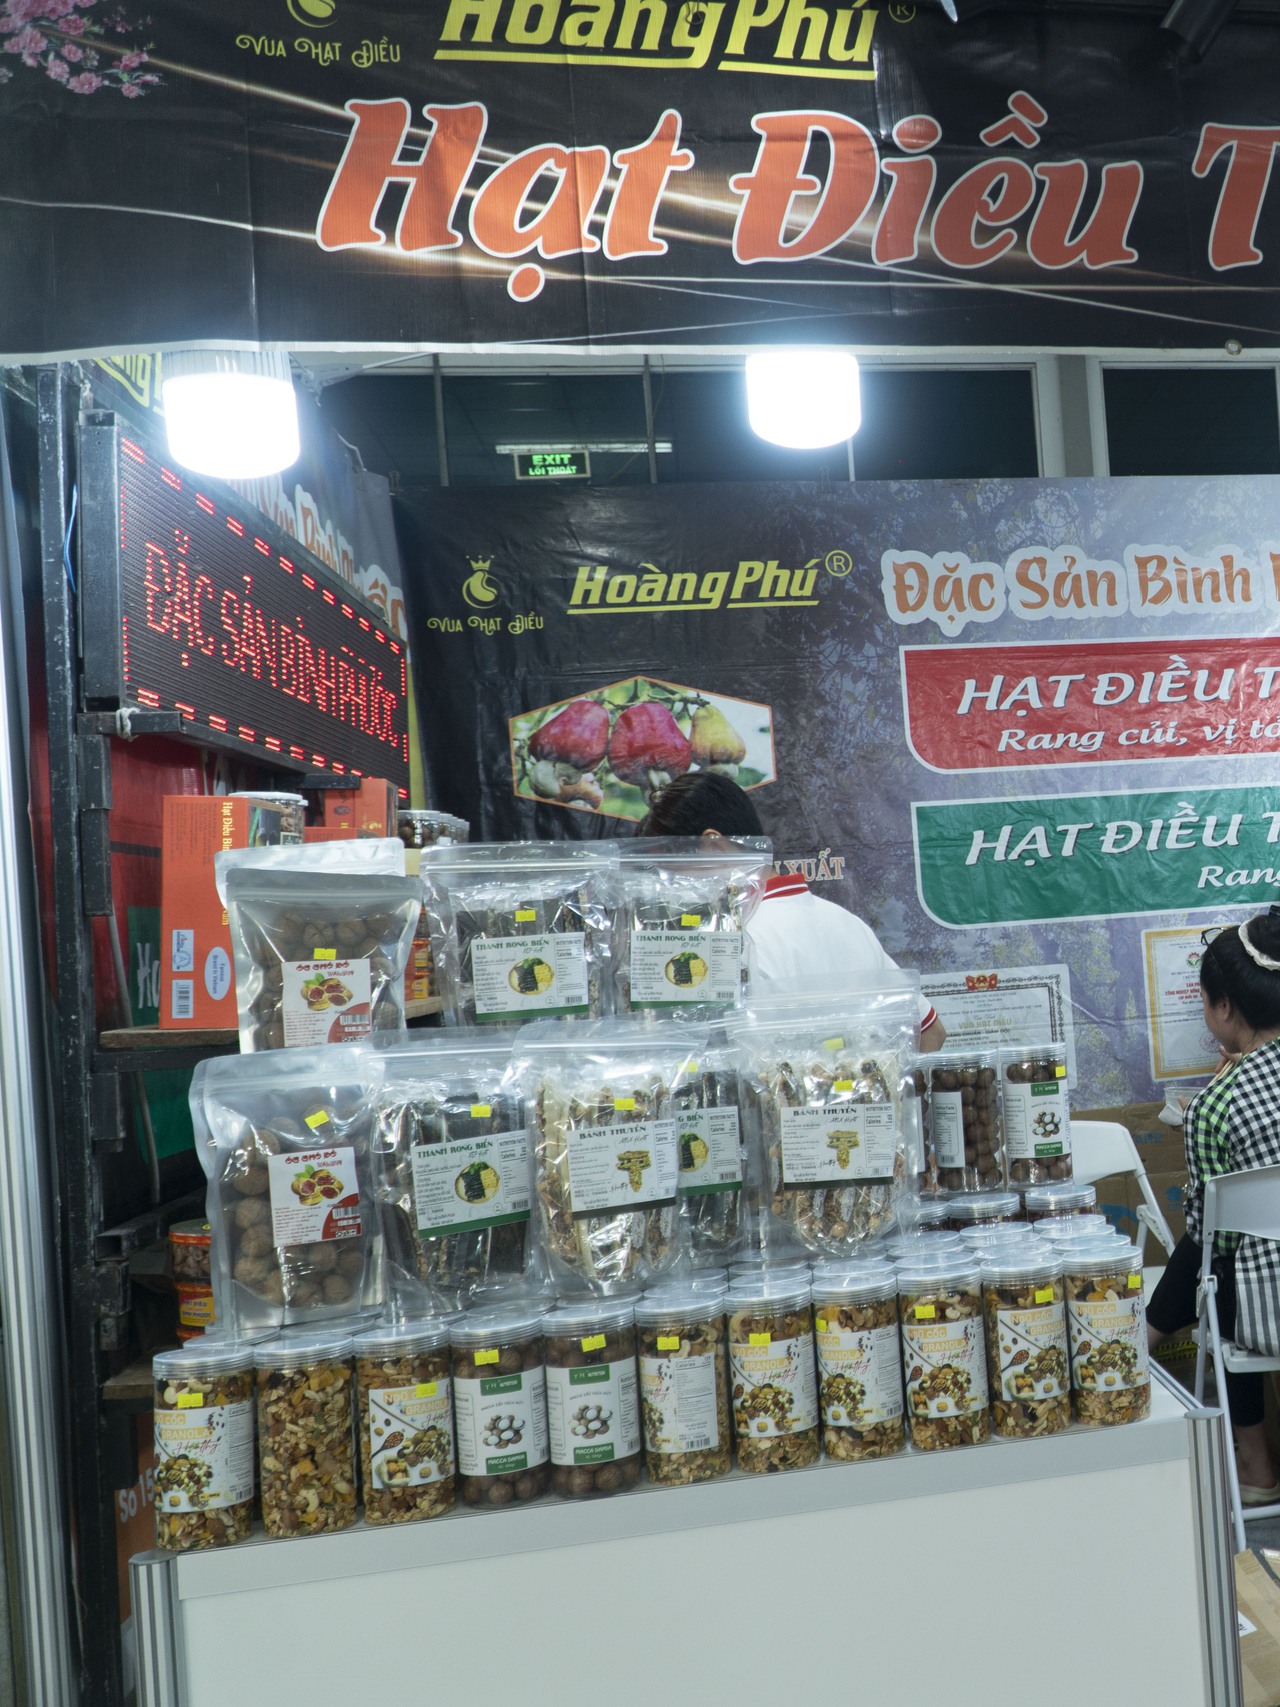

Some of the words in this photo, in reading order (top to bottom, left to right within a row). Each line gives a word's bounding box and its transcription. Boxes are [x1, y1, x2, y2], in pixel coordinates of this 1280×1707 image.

[236, 35, 287, 57] VUA
[294, 37, 342, 66] HẠT
[351, 36, 401, 68] ĐIỀU
[315, 97, 694, 302] Hạt
[729, 90, 1143, 271] Điều
[532, 453, 572, 465] EXIT
[547, 464, 577, 475] THOÁT
[568, 559, 822, 612] HoàngPhú
[891, 560, 997, 623] Đặc
[1014, 552, 1119, 609] Sản
[1133, 552, 1253, 606] Bình
[144, 529, 217, 666] ĐẶC
[220, 574, 279, 688] SẢN
[427, 616, 463, 633] VUA
[468, 615, 502, 636] HẠT
[508, 610, 544, 635] ĐIỀU
[957, 671, 1088, 718] HẠT
[1091, 654, 1235, 706] ĐIỀU
[996, 726, 1106, 753] Rang
[1117, 718, 1188, 748] củi,
[1202, 716, 1238, 744] vị
[964, 822, 1097, 869] HẠT
[1099, 801, 1244, 855] ĐIỀU
[665, 934, 686, 942] RONG
[475, 940, 504, 951] THANH
[506, 939, 529, 949] RONG
[793, 1109, 819, 1117] BÁNH
[579, 1128, 607, 1140] BÁNH
[417, 1148, 448, 1159] THANH
[450, 1144, 473, 1153] RONG
[1034, 1309, 1053, 1322] CÓC
[1097, 1303, 1117, 1315] CÓC
[1091, 1316, 1136, 1329] GRANOLA
[926, 1327, 946, 1338] CÓC
[922, 1339, 968, 1352] GRANOLA
[167, 1412, 186, 1425] CÓC
[575, 1447, 594, 1455] MACCA
[488, 1457, 507, 1465] MACCA
